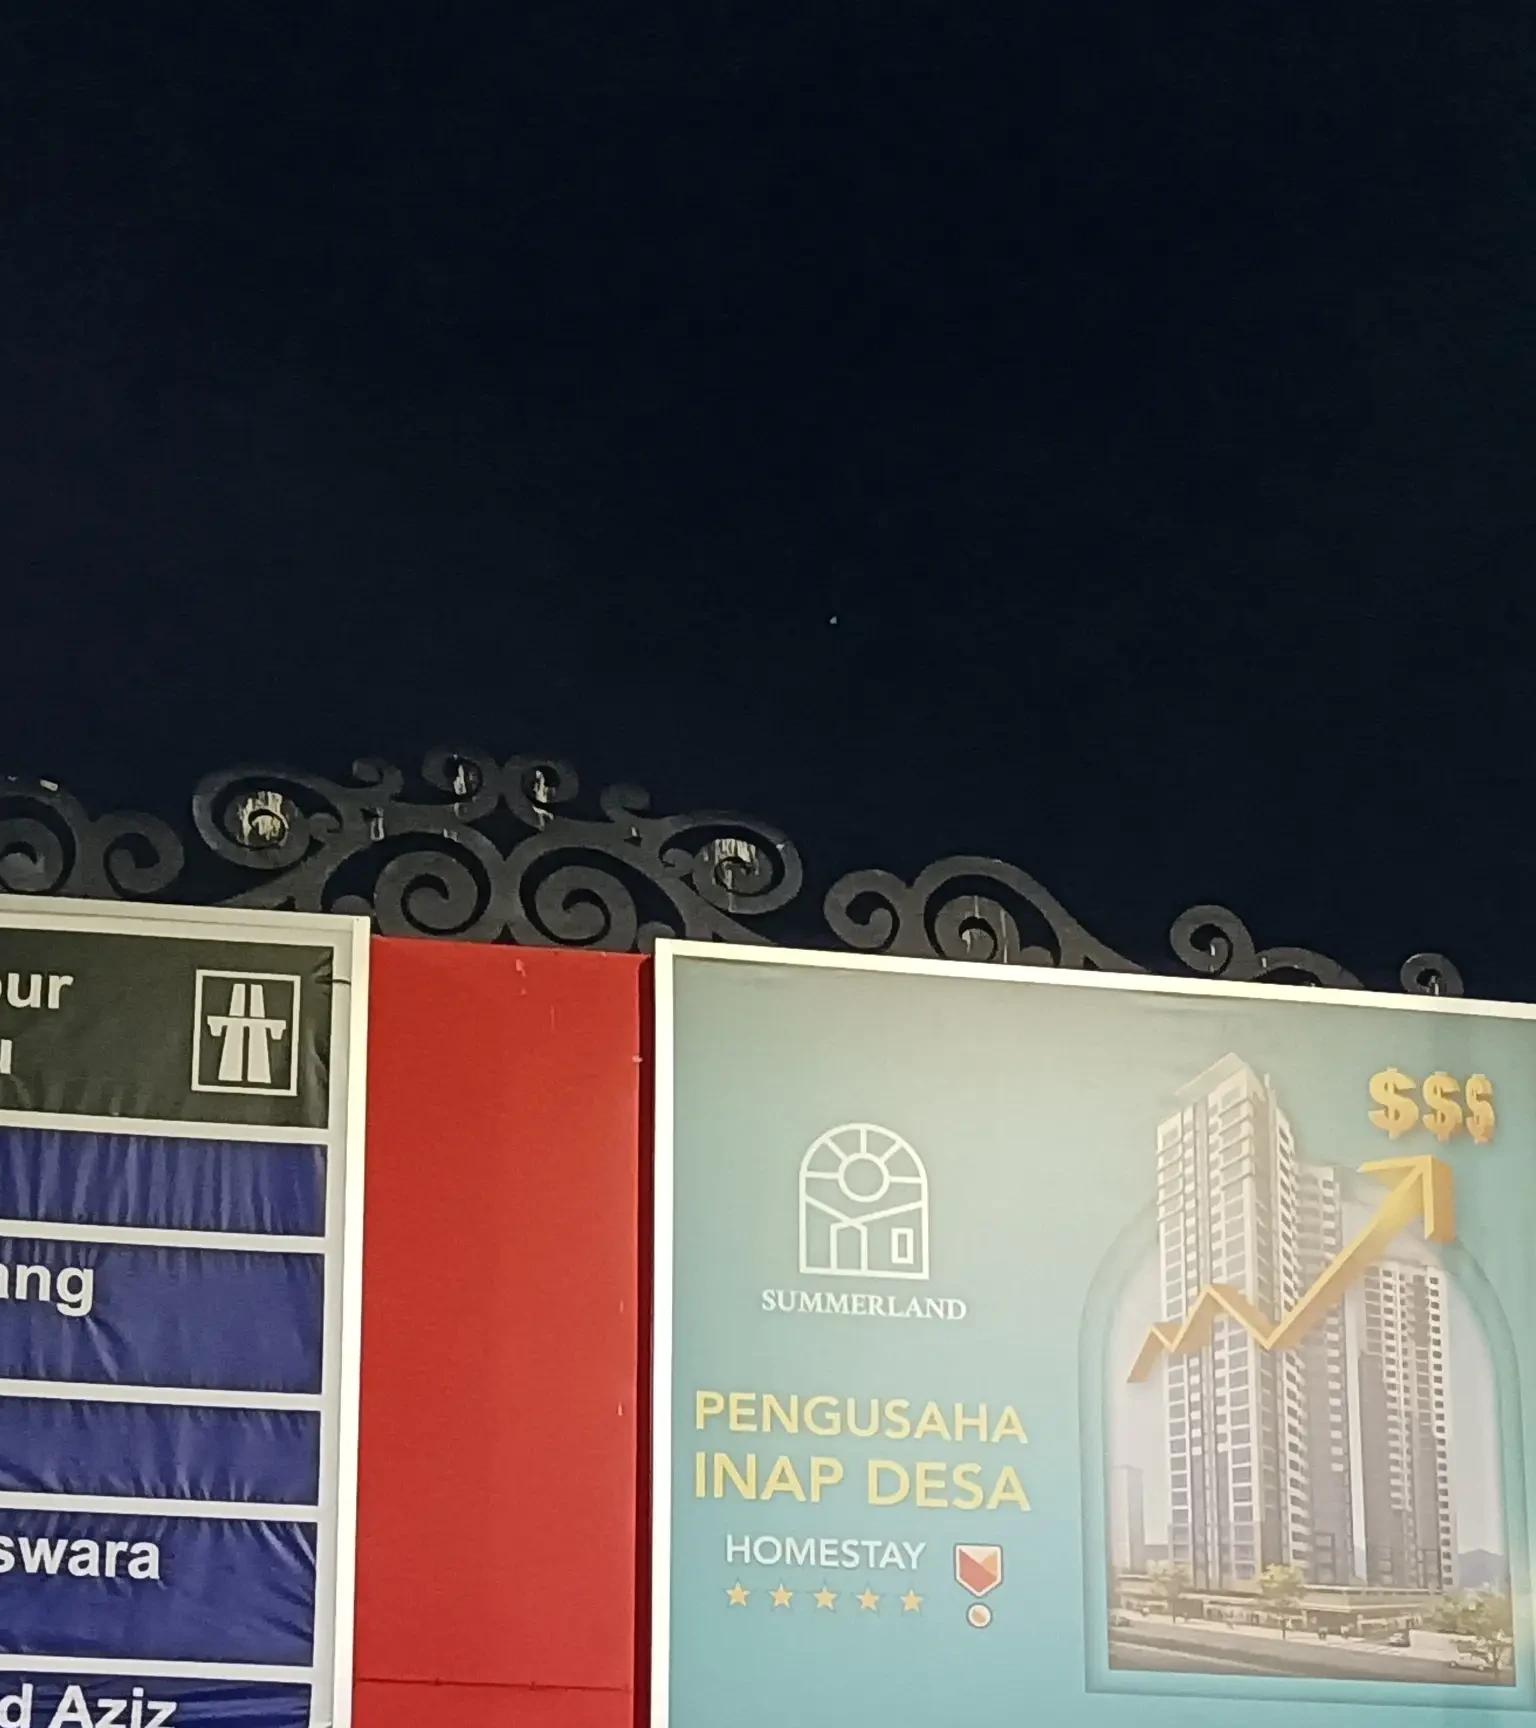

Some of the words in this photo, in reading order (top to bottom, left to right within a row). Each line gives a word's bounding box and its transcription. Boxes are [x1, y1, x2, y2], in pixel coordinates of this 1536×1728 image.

[761, 1288, 967, 1321] SUMMERLAND
[695, 1390, 1028, 1444] PENGUSAHA
[695, 1452, 844, 1503] INAP
[867, 1460, 1031, 1511] DESA
[725, 1534, 927, 1569] HOMESTAY
